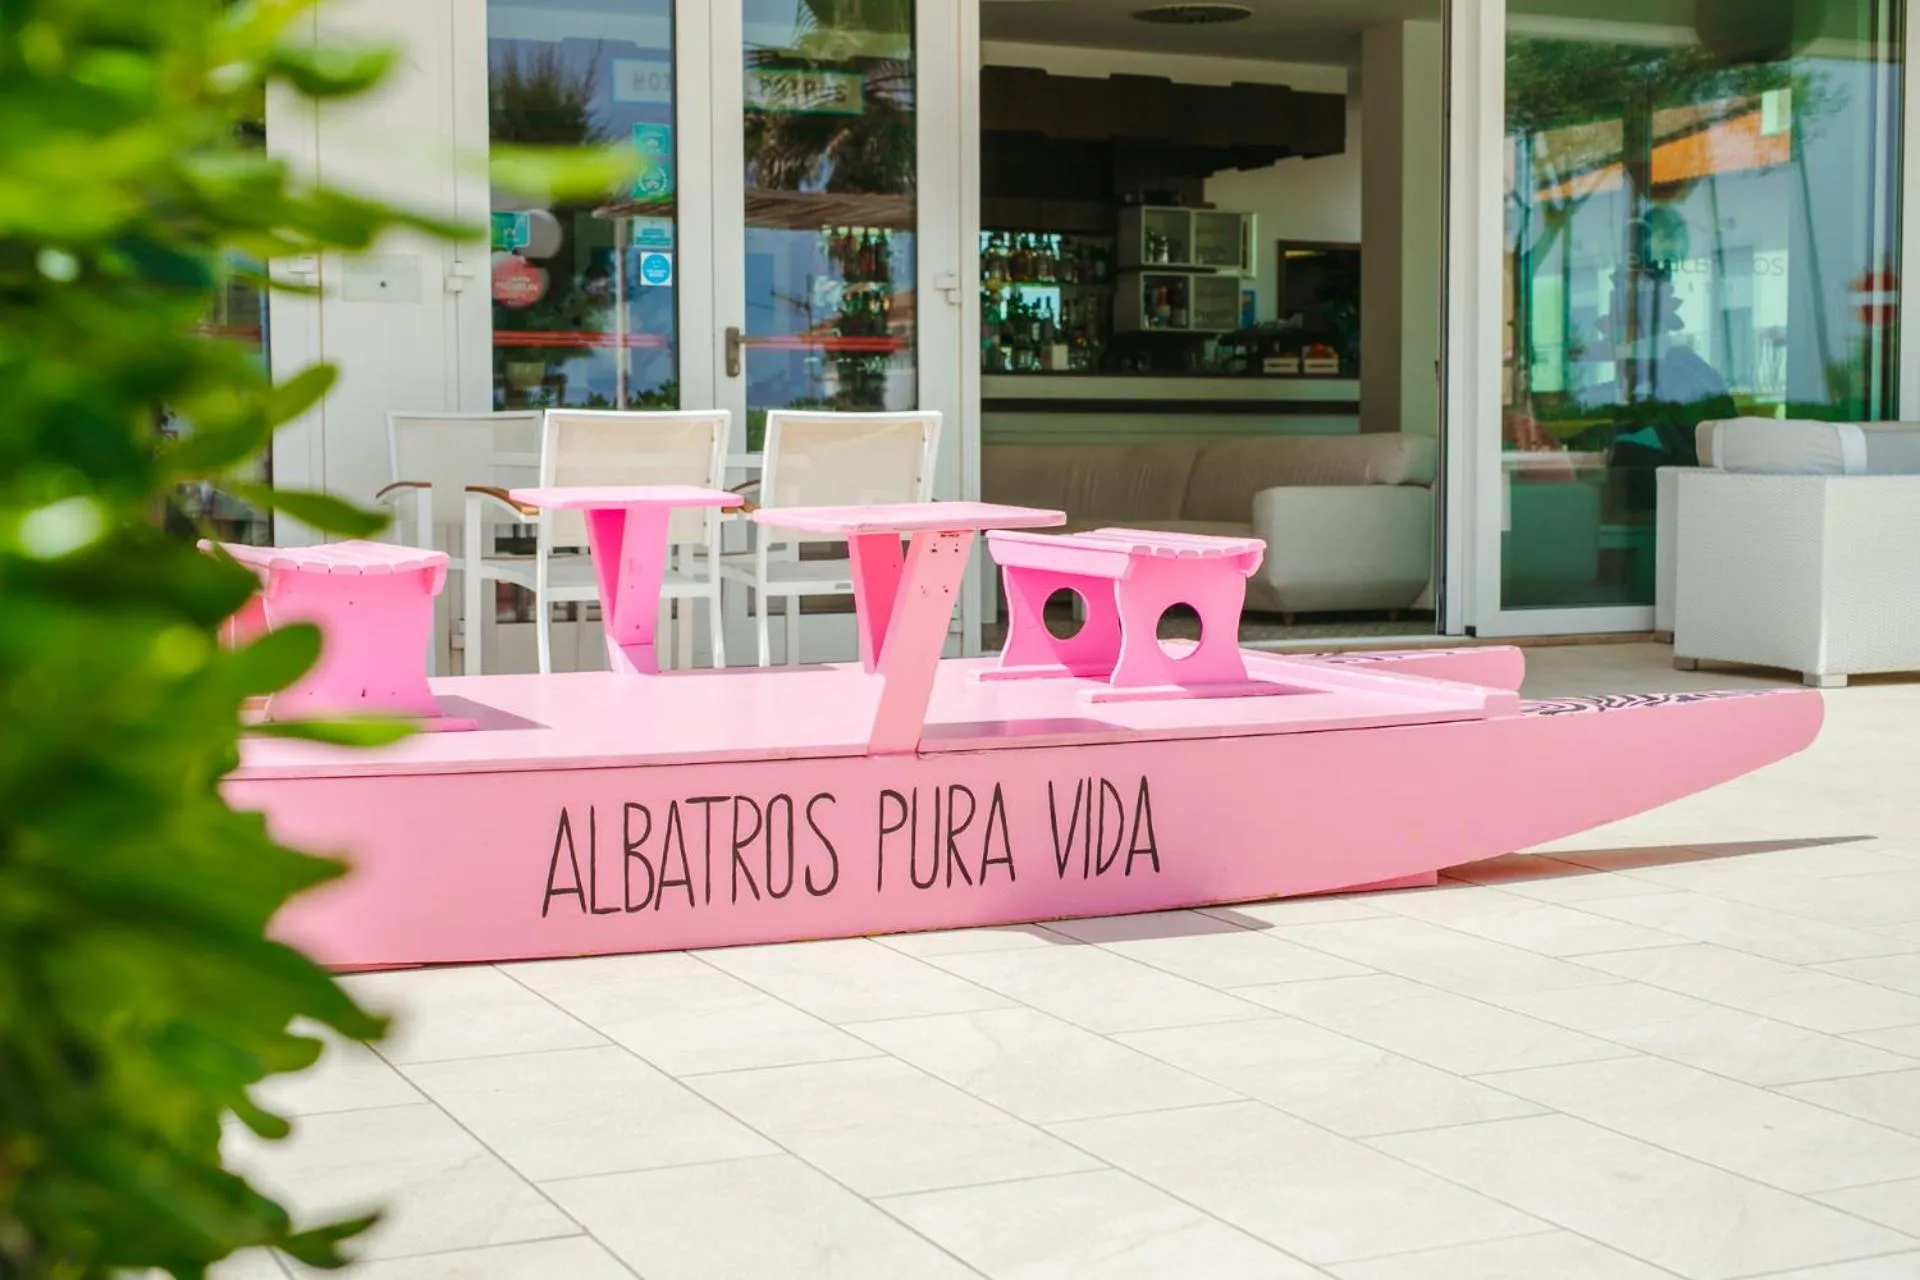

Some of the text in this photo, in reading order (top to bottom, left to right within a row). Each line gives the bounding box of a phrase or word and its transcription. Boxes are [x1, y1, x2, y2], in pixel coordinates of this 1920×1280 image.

[543, 776, 1160, 917] ALBATROS PURA VIDA
